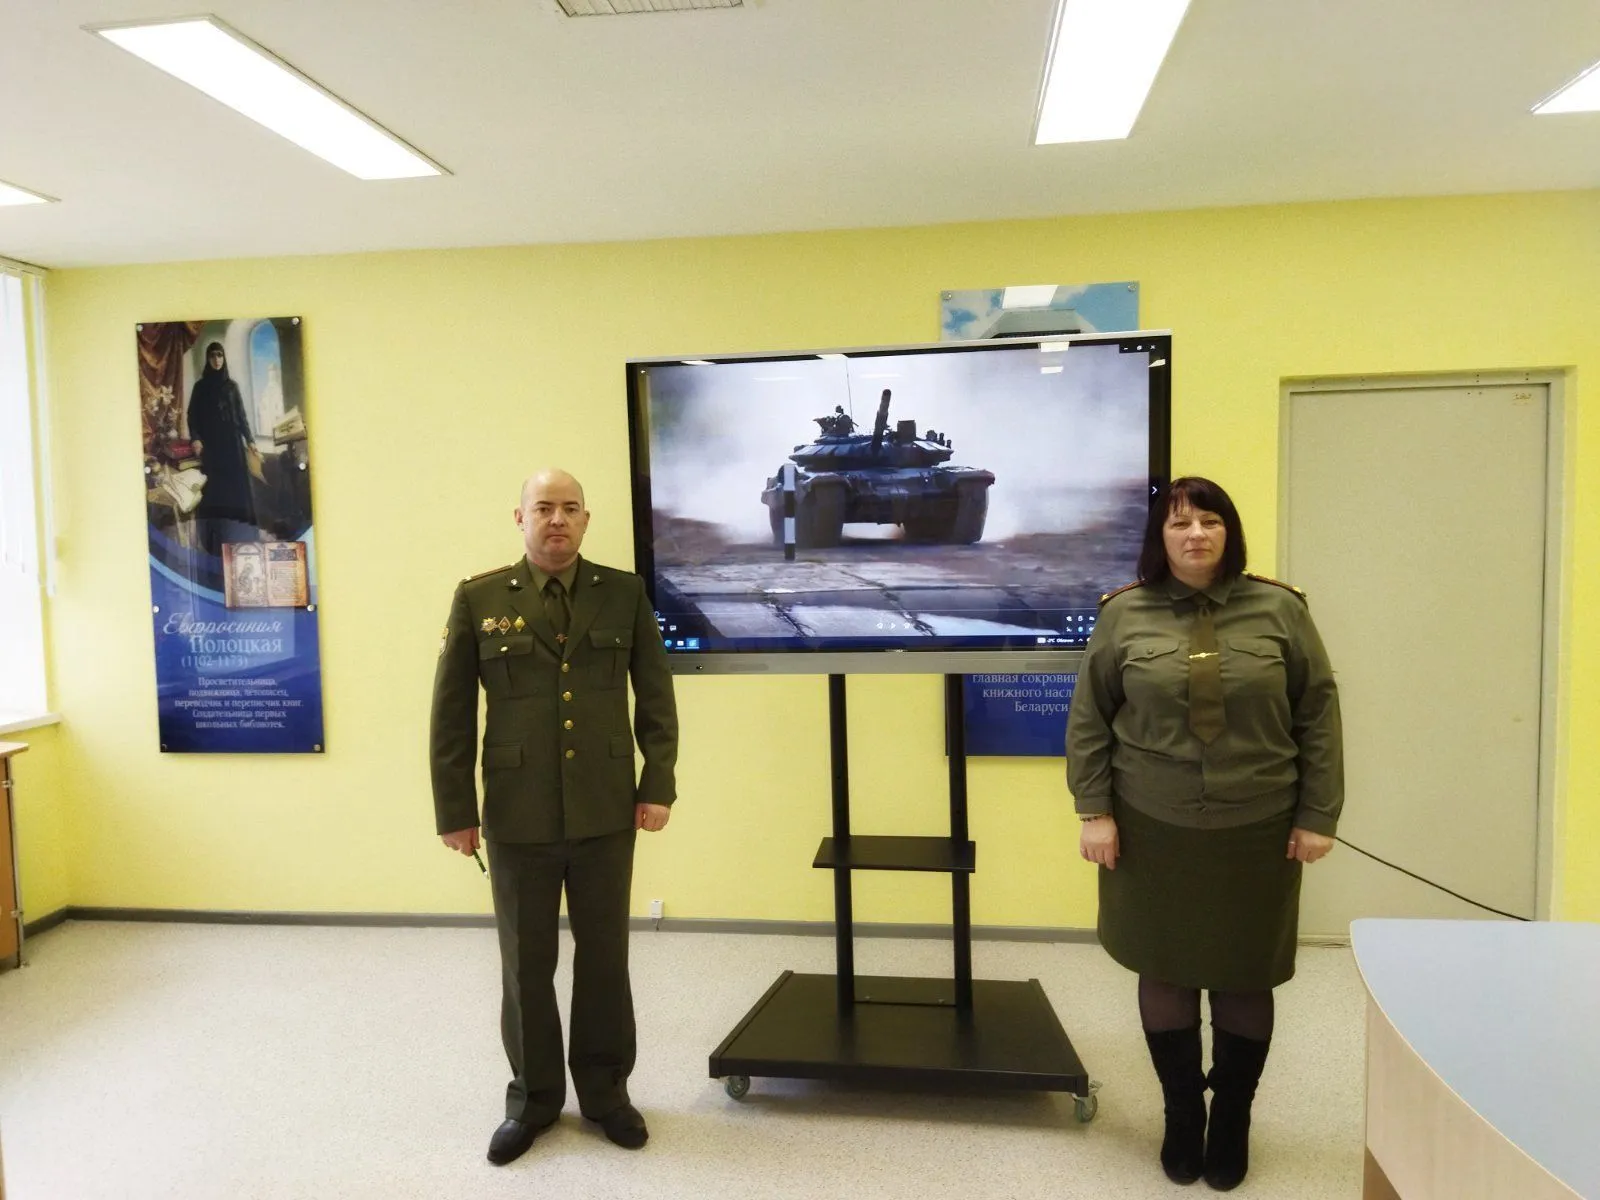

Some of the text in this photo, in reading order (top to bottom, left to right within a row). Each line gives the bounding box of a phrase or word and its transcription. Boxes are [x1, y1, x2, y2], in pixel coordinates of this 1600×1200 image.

[189, 636, 283, 655] Полоцкая
[972, 674, 1019, 683] главная
[983, 688, 1074, 698] книжного насл
